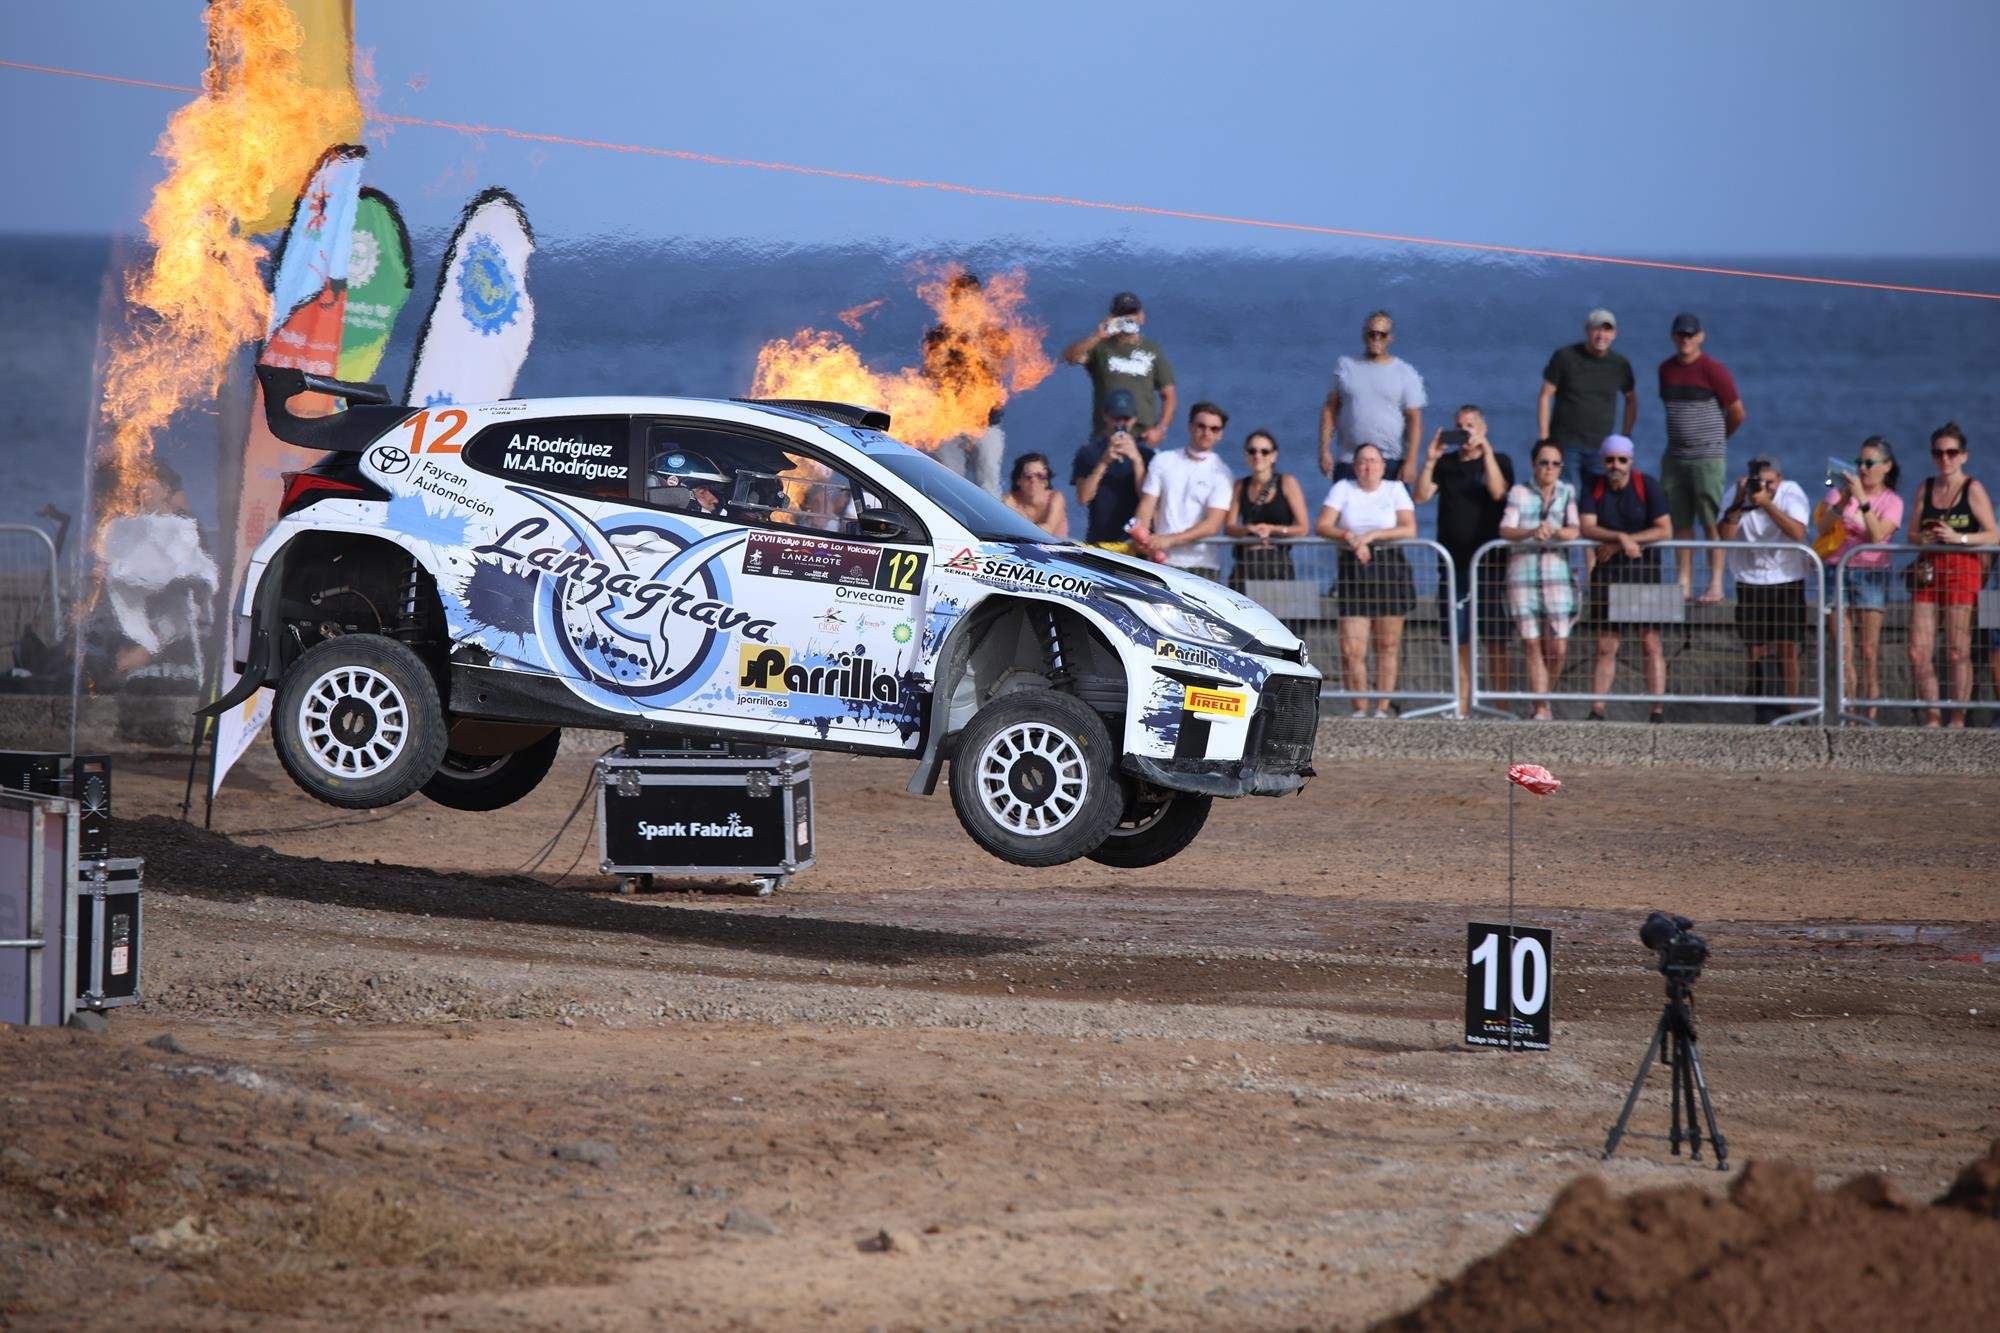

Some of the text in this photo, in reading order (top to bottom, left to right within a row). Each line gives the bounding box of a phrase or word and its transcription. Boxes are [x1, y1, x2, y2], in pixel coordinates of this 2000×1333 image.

[403, 409, 467, 454] 12
[507, 434, 613, 458] A.Rodríguez
[422, 461, 468, 487] Faycan
[503, 453, 628, 480] M.A.Rodríguez
[413, 476, 495, 516] Automoción
[750, 533, 776, 543] XXVII
[776, 536, 800, 547] Rallye
[817, 541, 829, 550] de
[830, 543, 844, 551] Los
[847, 544, 881, 556] Volcanes
[781, 552, 842, 566] LANZAROTE
[889, 552, 918, 592] 12
[472, 517, 777, 643] Lanzagrava
[982, 560, 1092, 595] SEÑALCON
[836, 586, 905, 606] Orvecame
[737, 694, 788, 708] jparrilla.es
[1190, 692, 1240, 712] PIRELLI
[638, 814, 753, 840] Spark Fabrica
[1472, 933, 1547, 1015] 10
